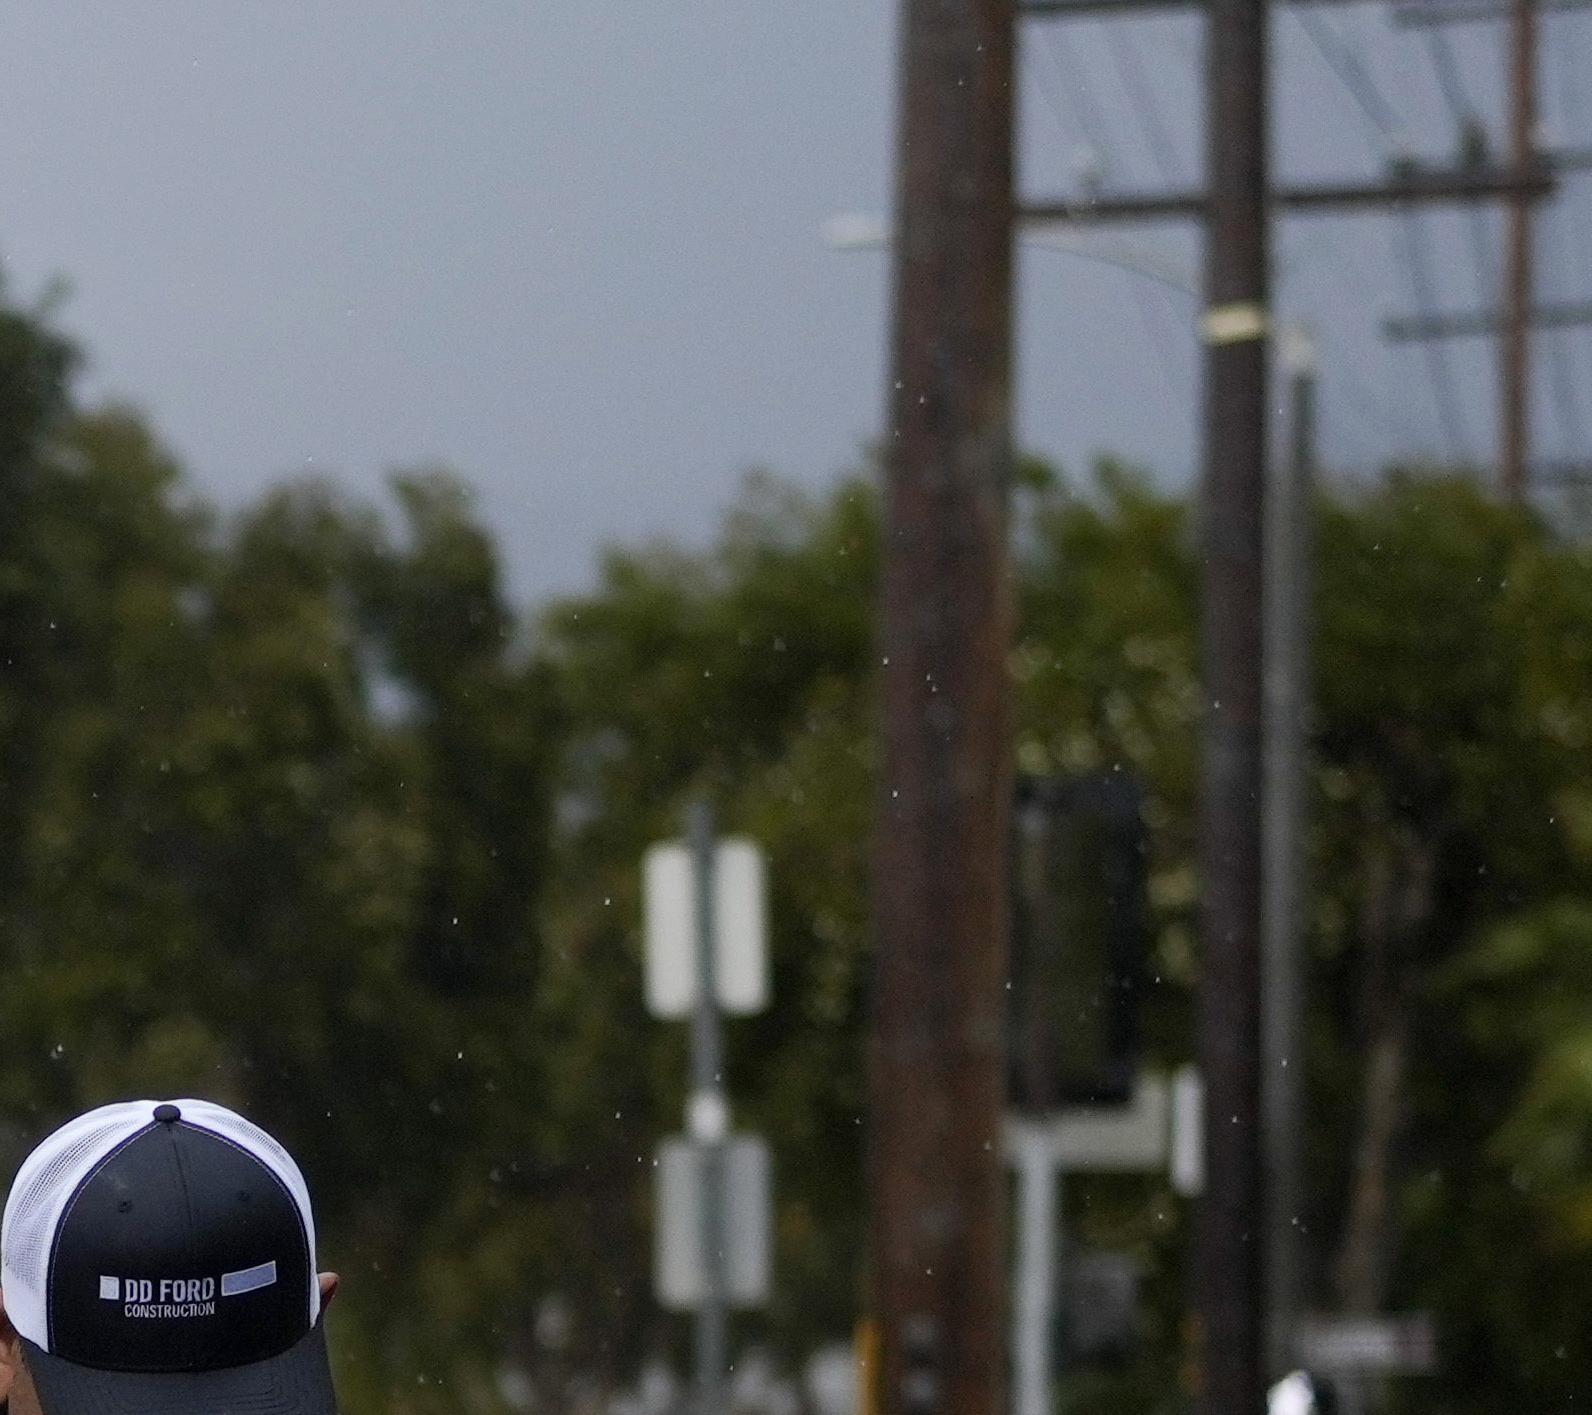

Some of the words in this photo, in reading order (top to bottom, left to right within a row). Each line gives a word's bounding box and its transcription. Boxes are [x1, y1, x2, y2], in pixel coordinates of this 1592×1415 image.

[125, 1279, 153, 1303] DD
[159, 1277, 215, 1303] FORD
[124, 1301, 216, 1318] CONSTRUCTION
